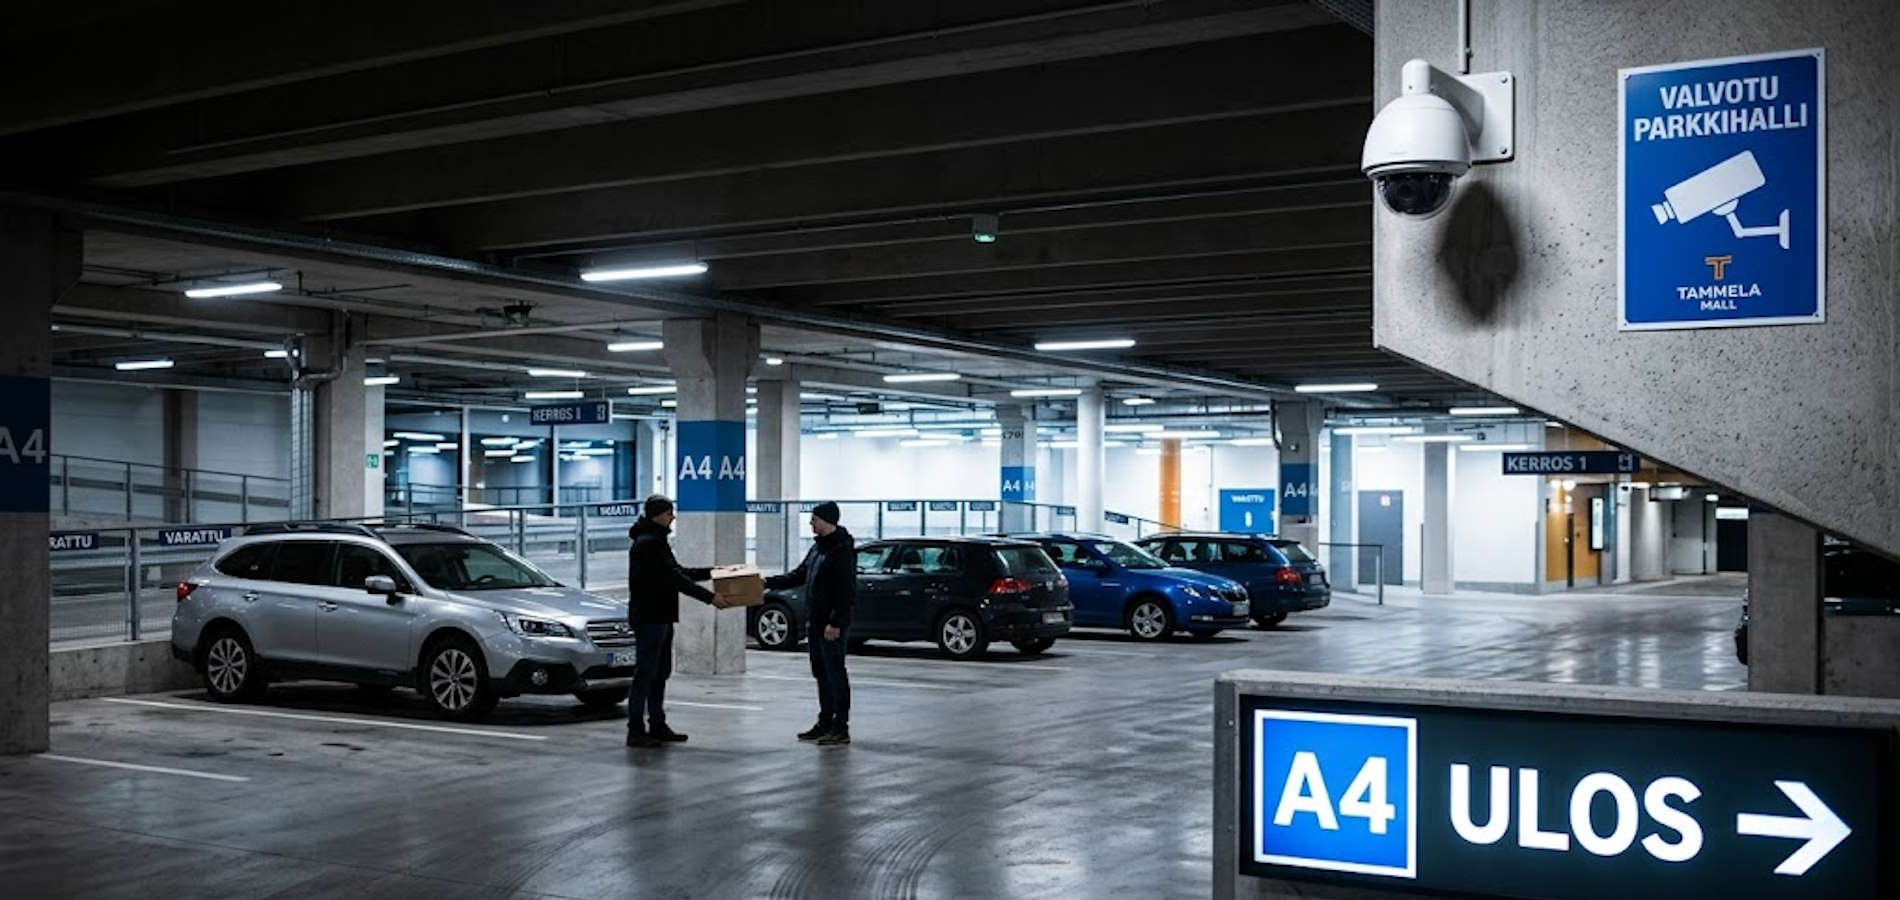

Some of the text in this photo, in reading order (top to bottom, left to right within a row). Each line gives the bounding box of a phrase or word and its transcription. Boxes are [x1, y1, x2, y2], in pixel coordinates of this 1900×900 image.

[1659, 75, 1779, 110] VALVOTU
[1634, 103, 1808, 142] PARKKIHALLI
[1676, 283, 1762, 300] TAMMELA
[1700, 300, 1738, 311] MALL
[0, 426, 47, 464] A4
[679, 455, 713, 480] A4
[718, 455, 745, 480] A4
[1507, 455, 1587, 471] KERROS 1
[1003, 479, 1021, 492] A4
[1284, 482, 1308, 498] A4
[165, 530, 224, 545] VARATTU
[1273, 751, 1703, 863] A4 ULOS
